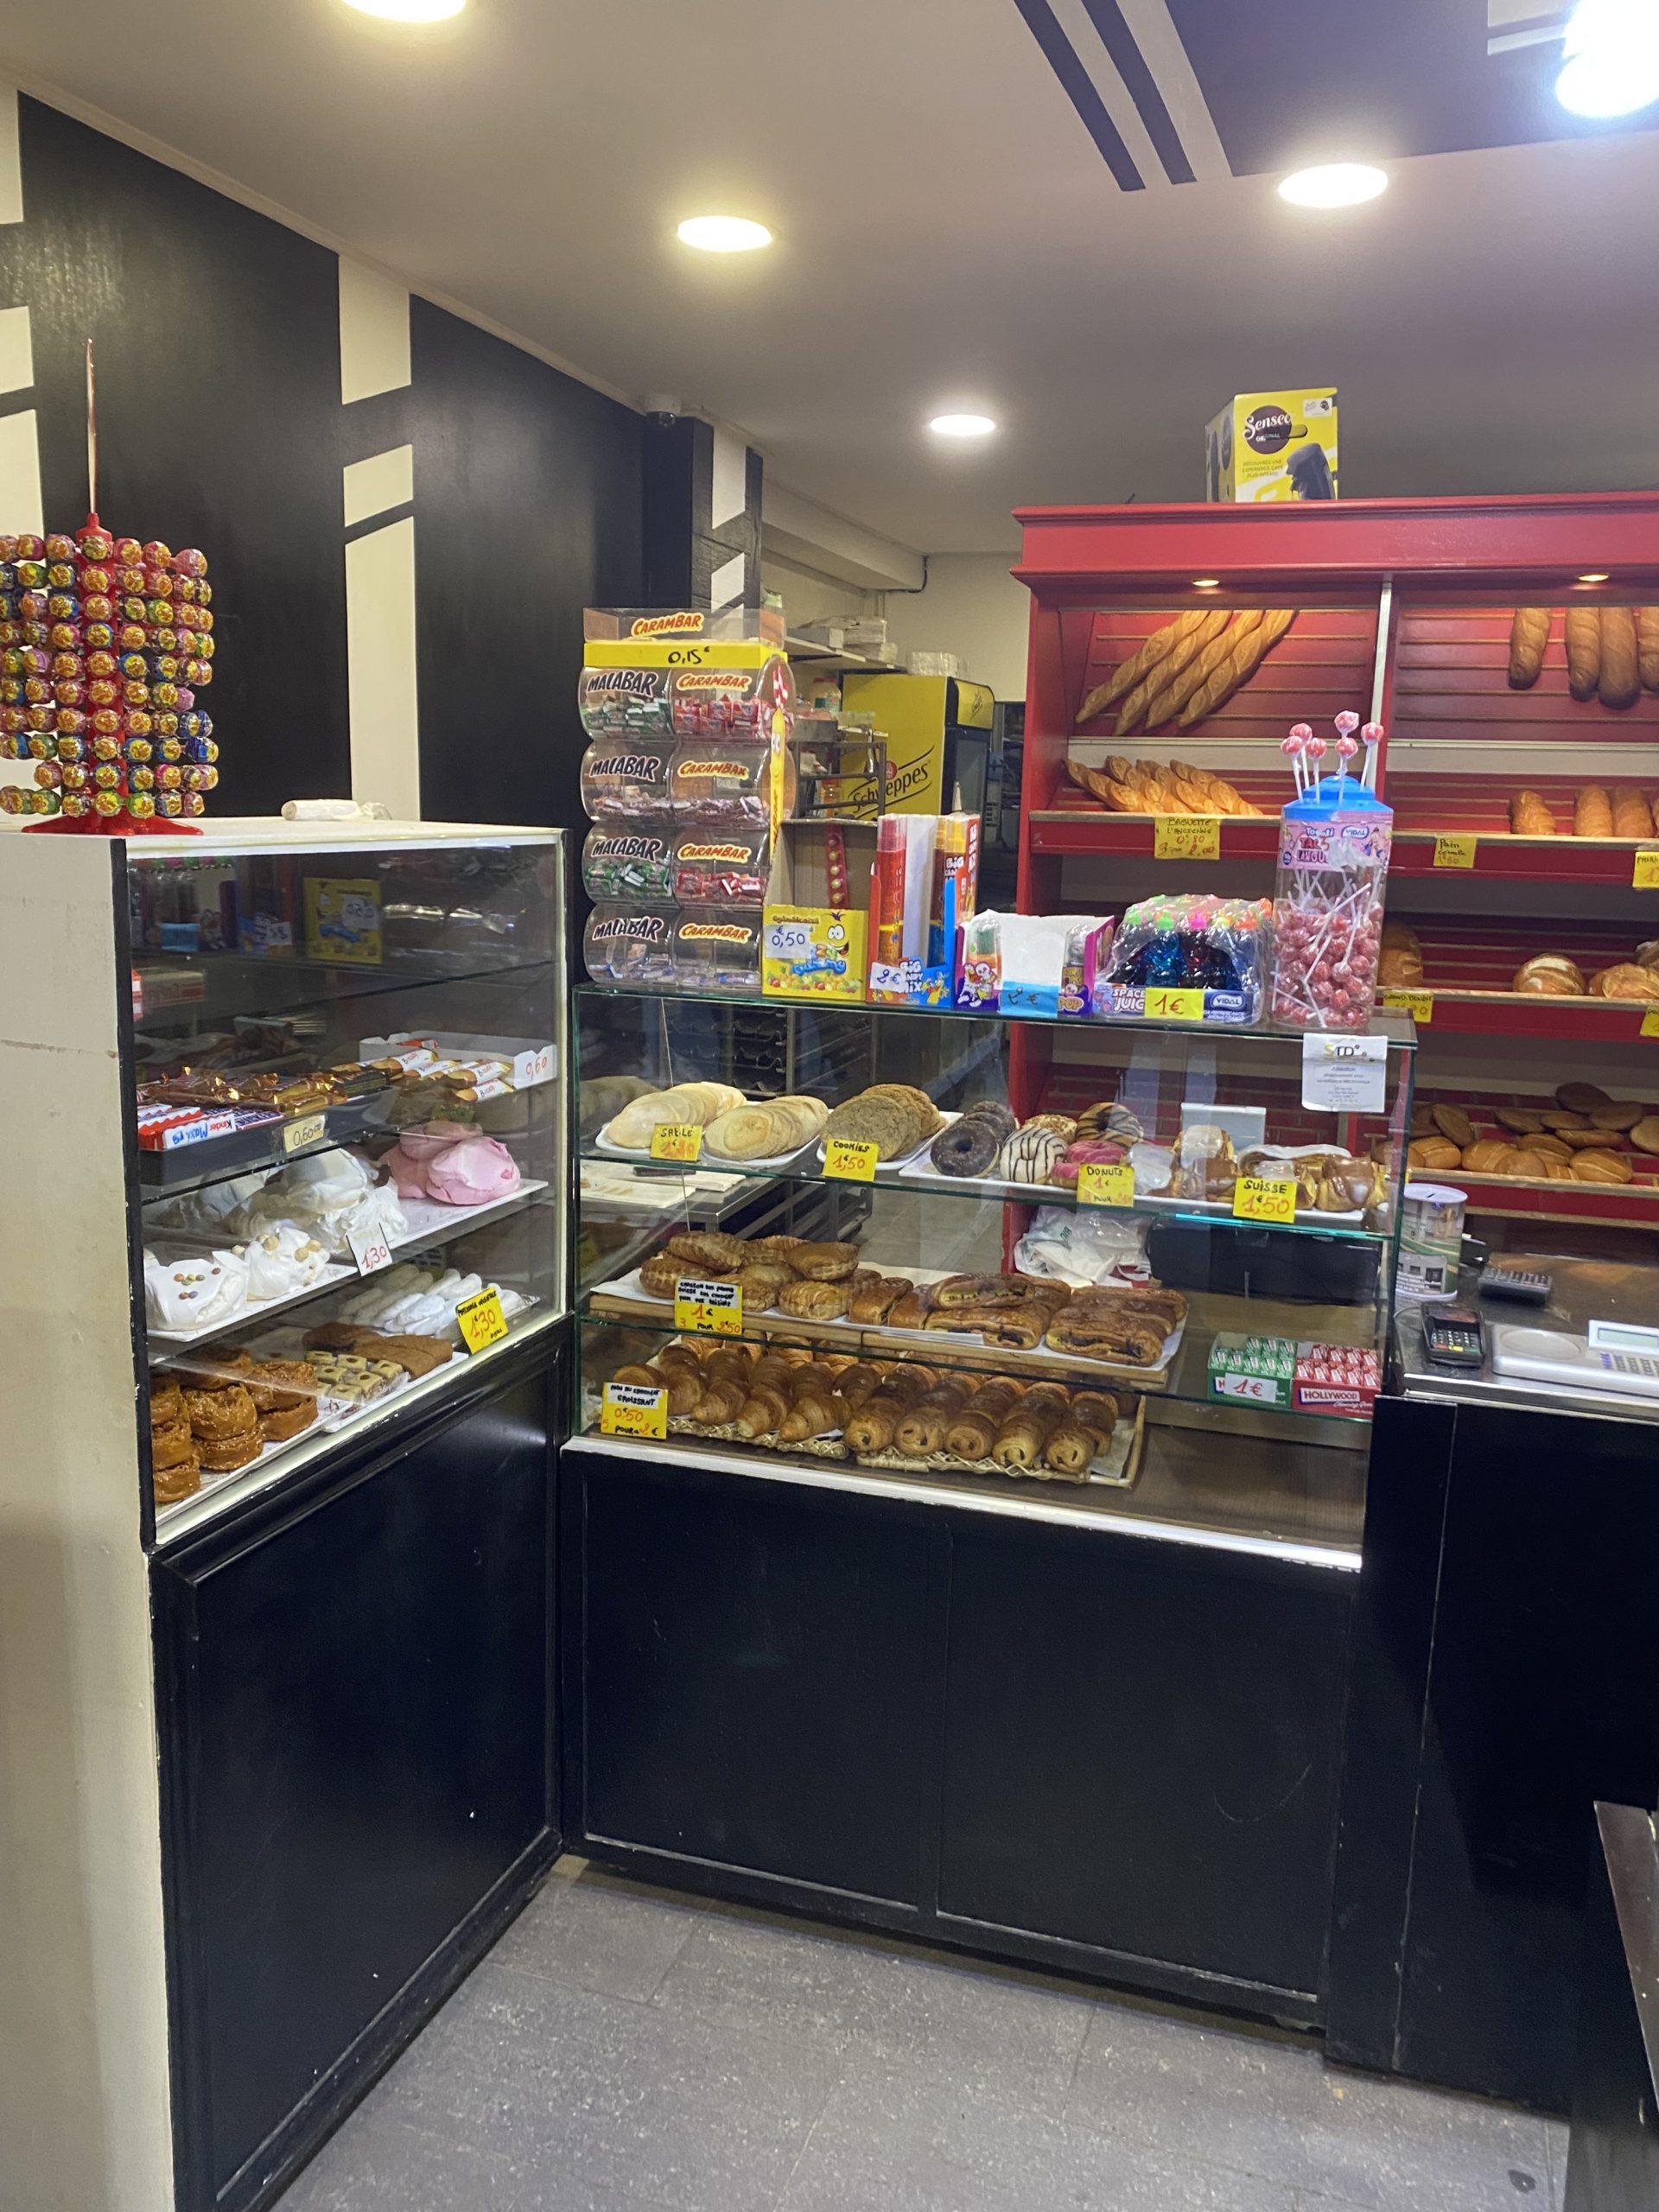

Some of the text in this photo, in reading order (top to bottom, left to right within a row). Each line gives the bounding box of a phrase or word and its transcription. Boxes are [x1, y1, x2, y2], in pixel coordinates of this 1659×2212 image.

[633, 614, 702, 635] CARAMBAR
[588, 672, 658, 696] MALABAR
[678, 676, 749, 689] CARAMBAR
[591, 756, 659, 781] MALABAR
[679, 761, 747, 777] CARAMBAR
[593, 837, 661, 862] MALABAR
[680, 845, 750, 860] CARAMBAR
[594, 917, 664, 942] MALABAR
[682, 925, 750, 940] CARAMBAR
[1115, 998, 1145, 1012] JUIC
[209, 1120, 232, 1132] Kinder
[1086, 1166, 1123, 1176] DONUTS
[1304, 1389, 1358, 1400] HOLLYWOOD
